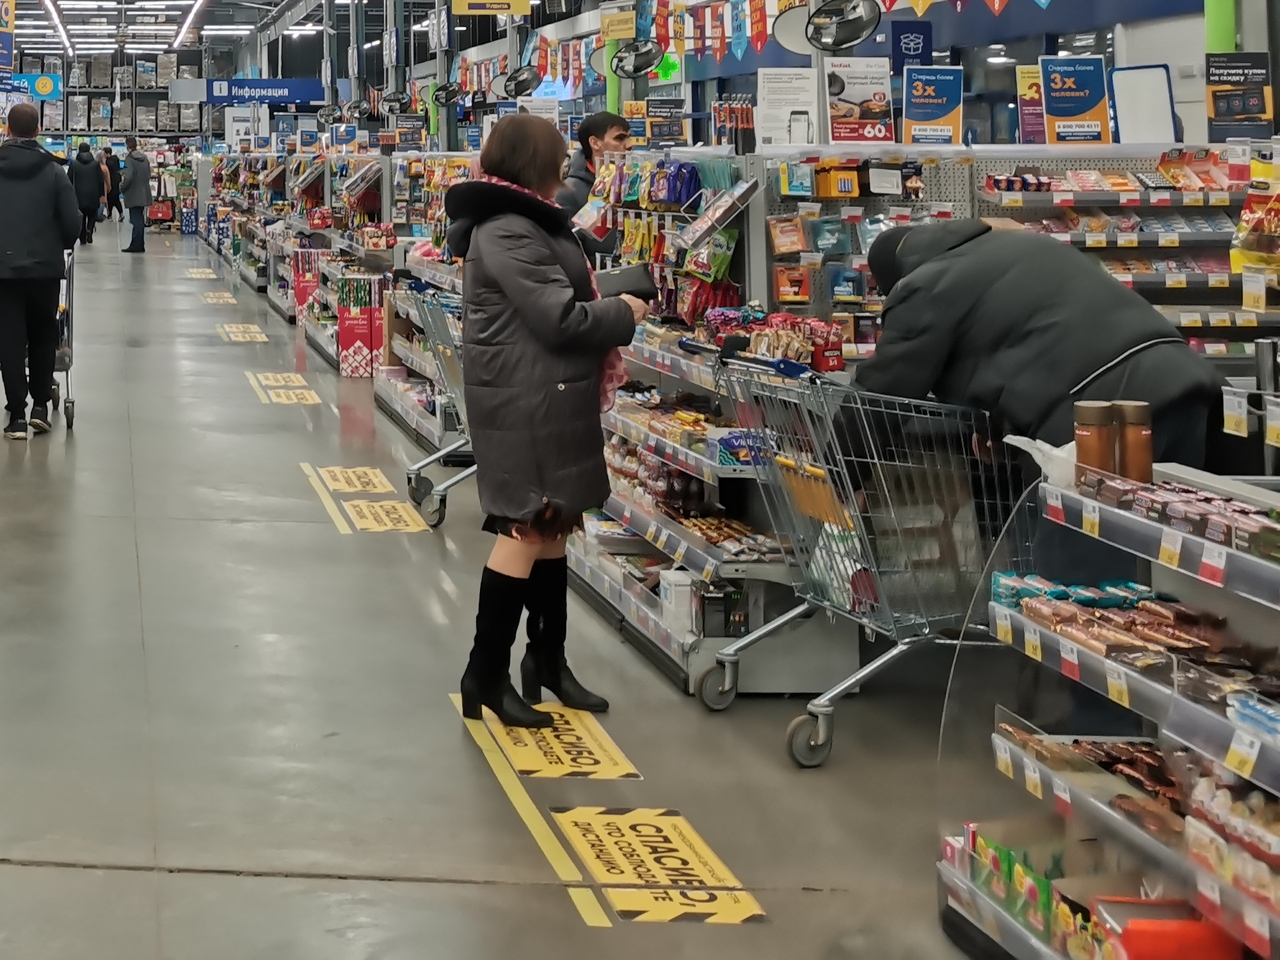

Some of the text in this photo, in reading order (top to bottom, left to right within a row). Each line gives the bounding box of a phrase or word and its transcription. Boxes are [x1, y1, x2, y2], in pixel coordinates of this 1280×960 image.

[912, 81, 936, 96] 3х
[1050, 73, 1076, 89] 3х
[232, 86, 288, 98] Информация
[863, 124, 886, 138] 60
[570, 820, 626, 876] ДИСТАНЦИЮ
[602, 822, 674, 902] ЧТО СОБЛЮДАТЕ
